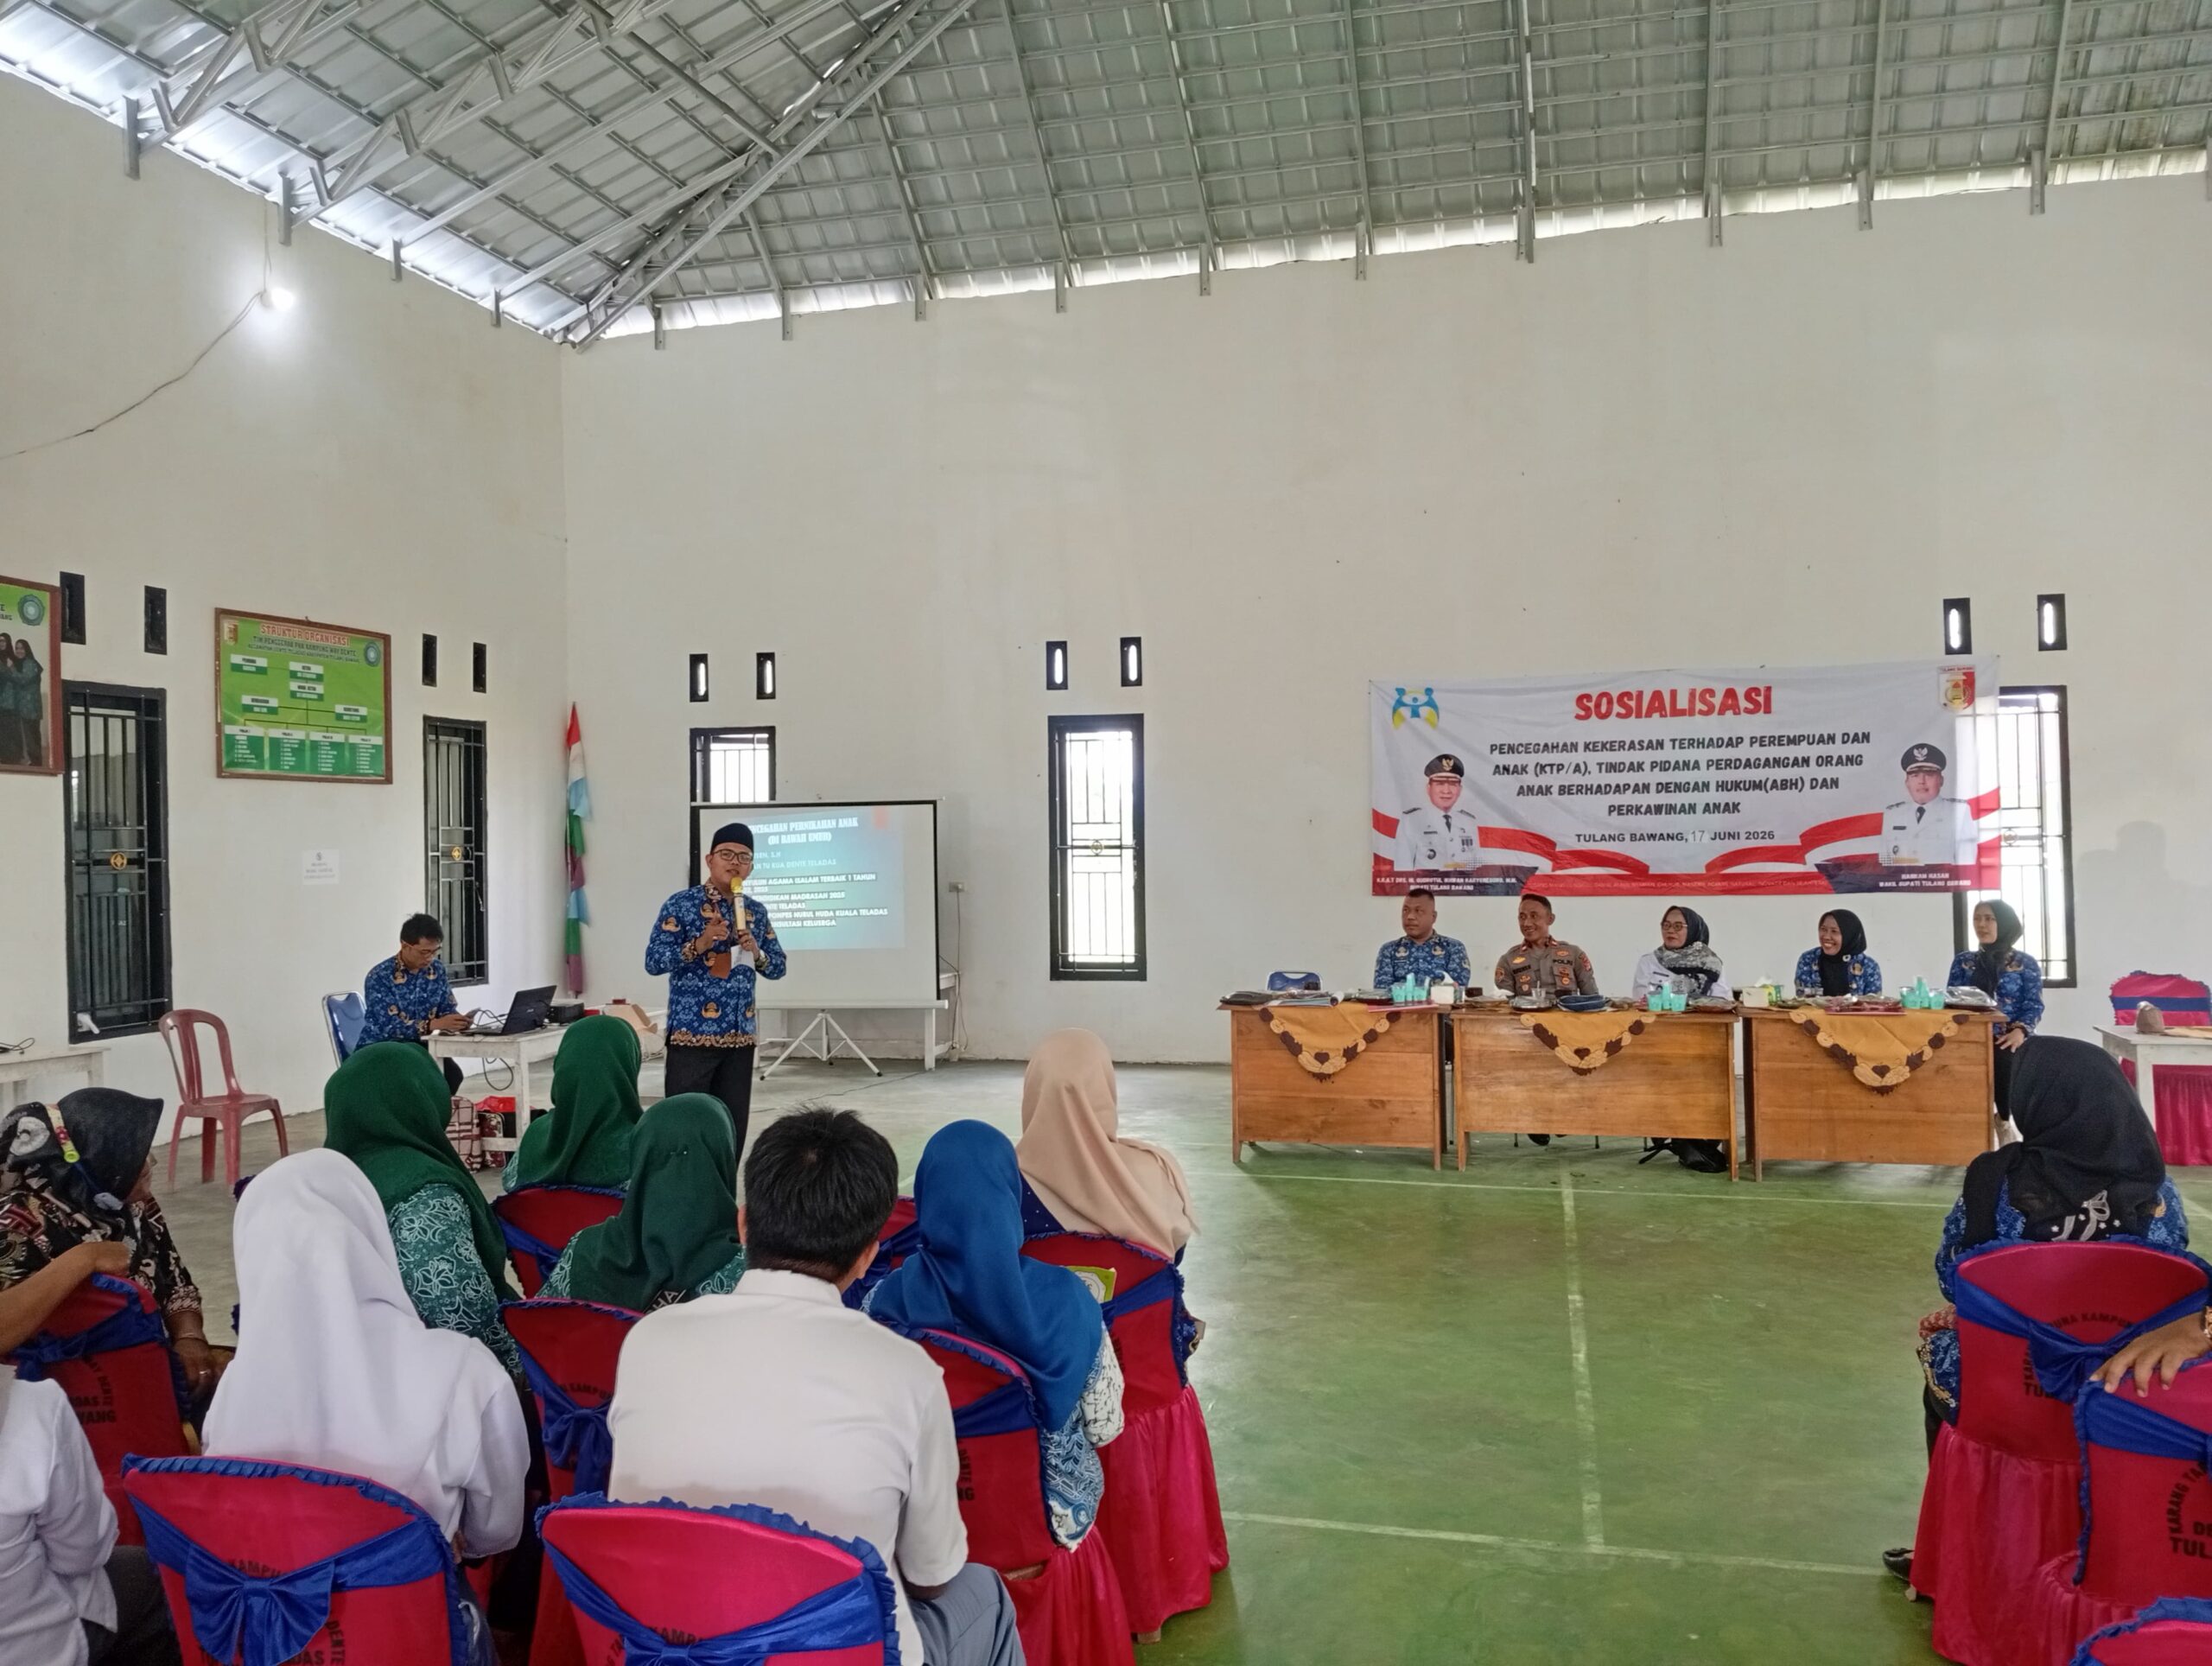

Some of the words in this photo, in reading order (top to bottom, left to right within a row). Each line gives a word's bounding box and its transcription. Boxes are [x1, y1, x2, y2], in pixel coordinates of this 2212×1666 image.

[261, 624, 302, 639] STRUKTUR
[304, 630, 351, 645] ORGANISASI
[1574, 686, 1772, 721] SOSIALISASI
[1490, 741, 1579, 755] PENCEGAHAN
[1583, 739, 1664, 753] KEKERASAN
[1669, 736, 1744, 750] TERHADAP
[1749, 733, 1835, 748] PEREMPUAN
[1841, 732, 1871, 744] DAN
[1492, 763, 1529, 776] ANAK
[1534, 760, 1592, 778] (KTP/A),
[1596, 761, 1645, 774] TINDAK
[1650, 759, 1700, 772] PIDANA
[1707, 756, 1811, 771] PERDAGANGAN
[1815, 754, 1864, 767] ORANG
[1516, 785, 1554, 797] ANAK
[1558, 782, 1650, 796] BERHADAPAN
[1656, 780, 1710, 794] DENGAN
[1715, 776, 1805, 793] HUKUM(ABH)
[1809, 777, 1840, 790] DAN
[1608, 803, 1697, 816] PERKAWINAN
[1702, 802, 1741, 814] ANAK
[789, 818, 836, 831] PERNIKAHAN
[838, 817, 859, 828] ANAK
[781, 833, 807, 844] BAWAH
[1575, 833, 1625, 843] TULANG
[1630, 832, 1688, 843] BAWANG,
[1690, 830, 1706, 843] 17
[1710, 831, 1741, 842] JUNI
[1745, 830, 1776, 841] 2026
